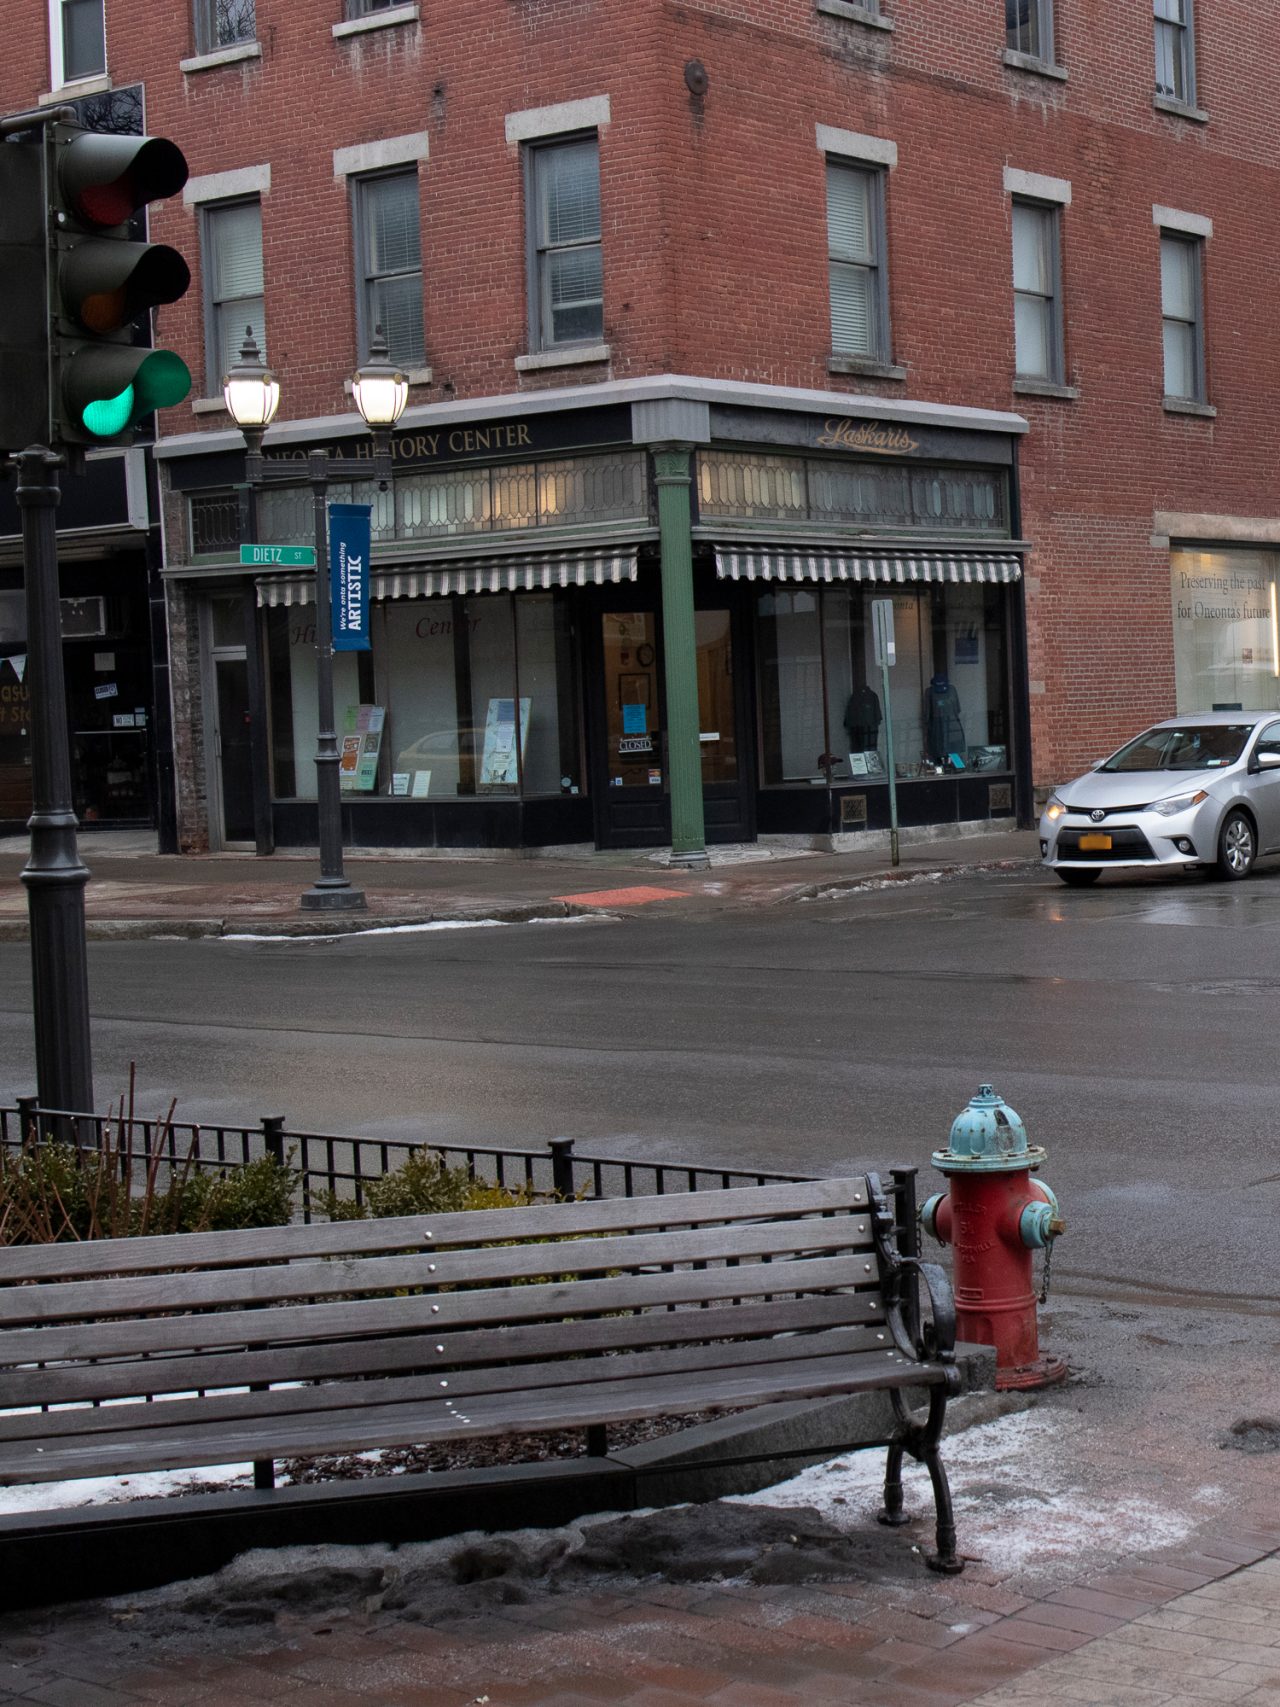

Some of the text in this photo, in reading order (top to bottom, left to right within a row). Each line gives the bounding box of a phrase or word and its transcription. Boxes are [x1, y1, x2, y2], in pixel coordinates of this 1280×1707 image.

[449, 423, 532, 452] CENTER
[253, 547, 302, 562] DIETZ ST
[339, 542, 347, 584] something
[347, 555, 362, 631] ARTISTIC
[1180, 571, 1266, 595] Preserving the past
[339, 608, 347, 630] We're
[1177, 600, 1271, 619] for Oneonta's future
[619, 740, 651, 751] CLOSED
